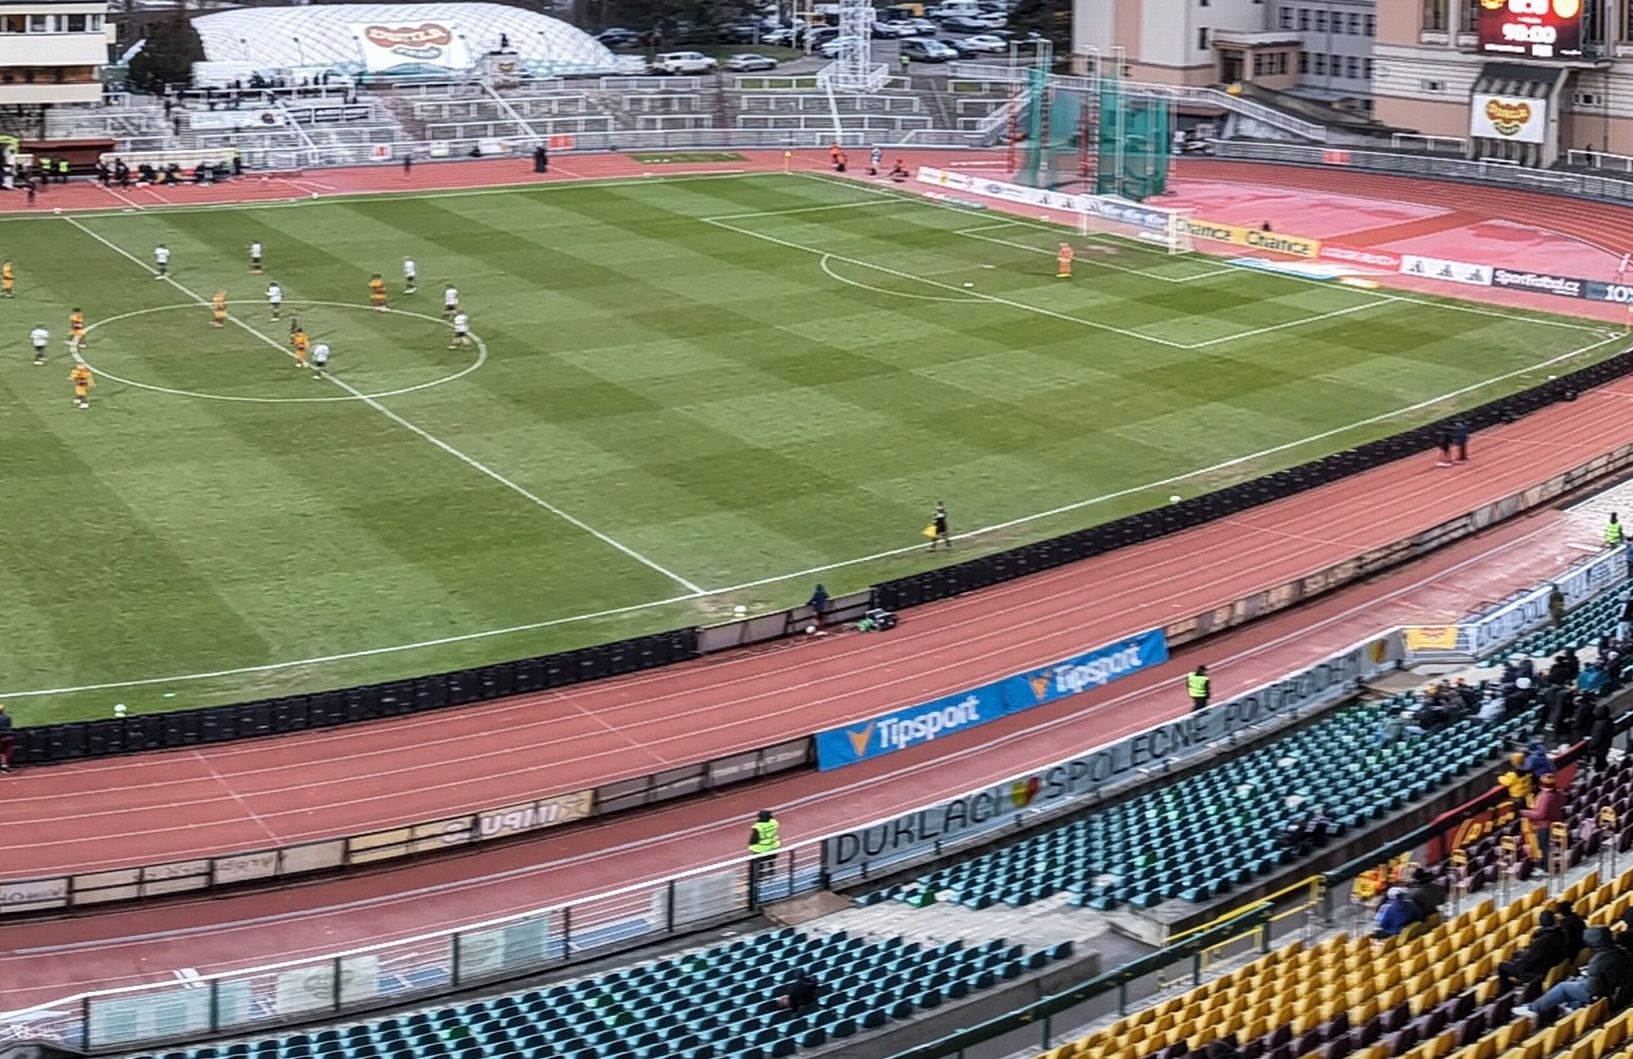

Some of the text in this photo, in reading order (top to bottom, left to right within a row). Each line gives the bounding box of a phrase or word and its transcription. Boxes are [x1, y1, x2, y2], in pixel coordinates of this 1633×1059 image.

[1245, 230, 1313, 256] Chance
[1053, 643, 1143, 693] Tipsport
[876, 694, 981, 749] Tipsport
